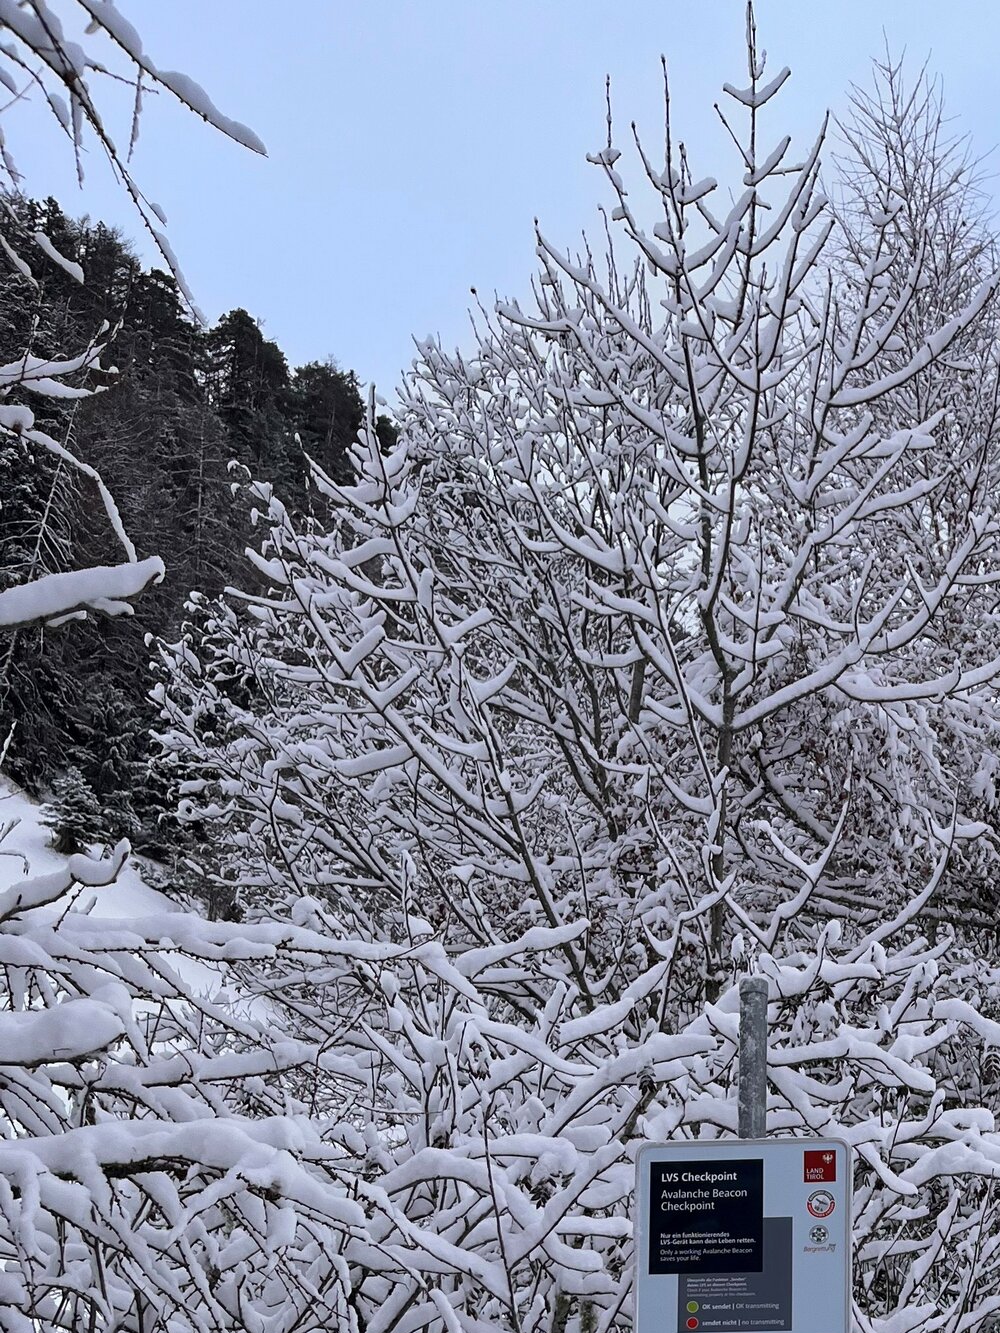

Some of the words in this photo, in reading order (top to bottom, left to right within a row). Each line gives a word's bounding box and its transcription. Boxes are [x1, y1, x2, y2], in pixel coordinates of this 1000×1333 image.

[662, 1172, 679, 1182] LVS
[681, 1171, 738, 1184] Checkpoint
[661, 1188, 710, 1199] Avalanche
[712, 1188, 748, 1198] Beacon
[660, 1201, 715, 1212] Checkpoint
